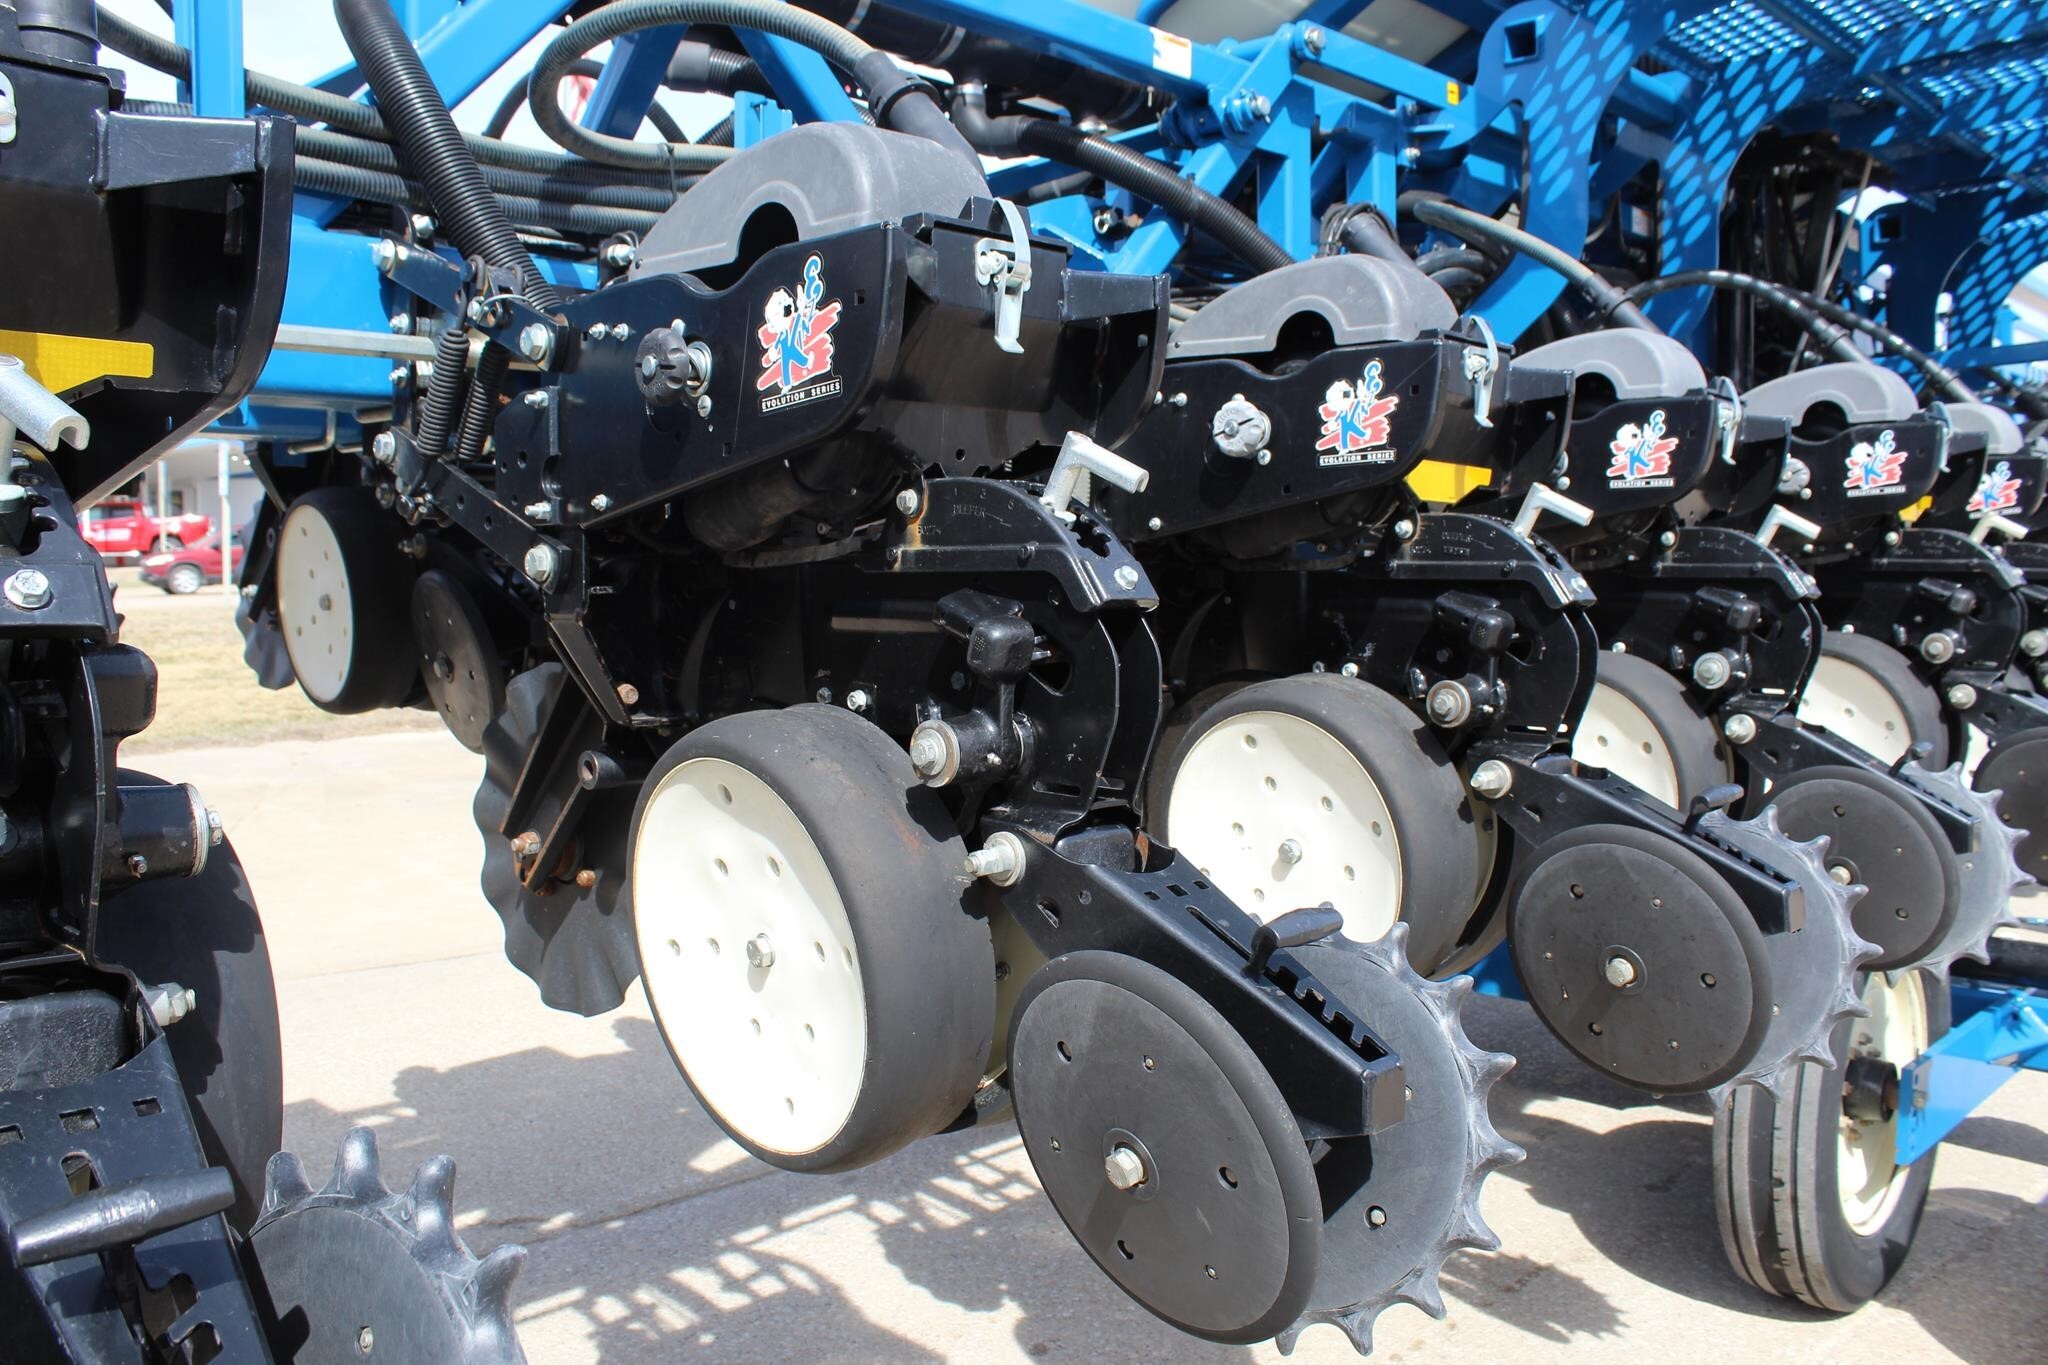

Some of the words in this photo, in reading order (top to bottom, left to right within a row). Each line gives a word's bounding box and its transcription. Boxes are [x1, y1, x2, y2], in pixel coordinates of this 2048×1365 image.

[761, 391, 805, 410] EVOLUTION
[811, 382, 841, 396] SERIES
[1320, 455, 1362, 464] EVOLUTION
